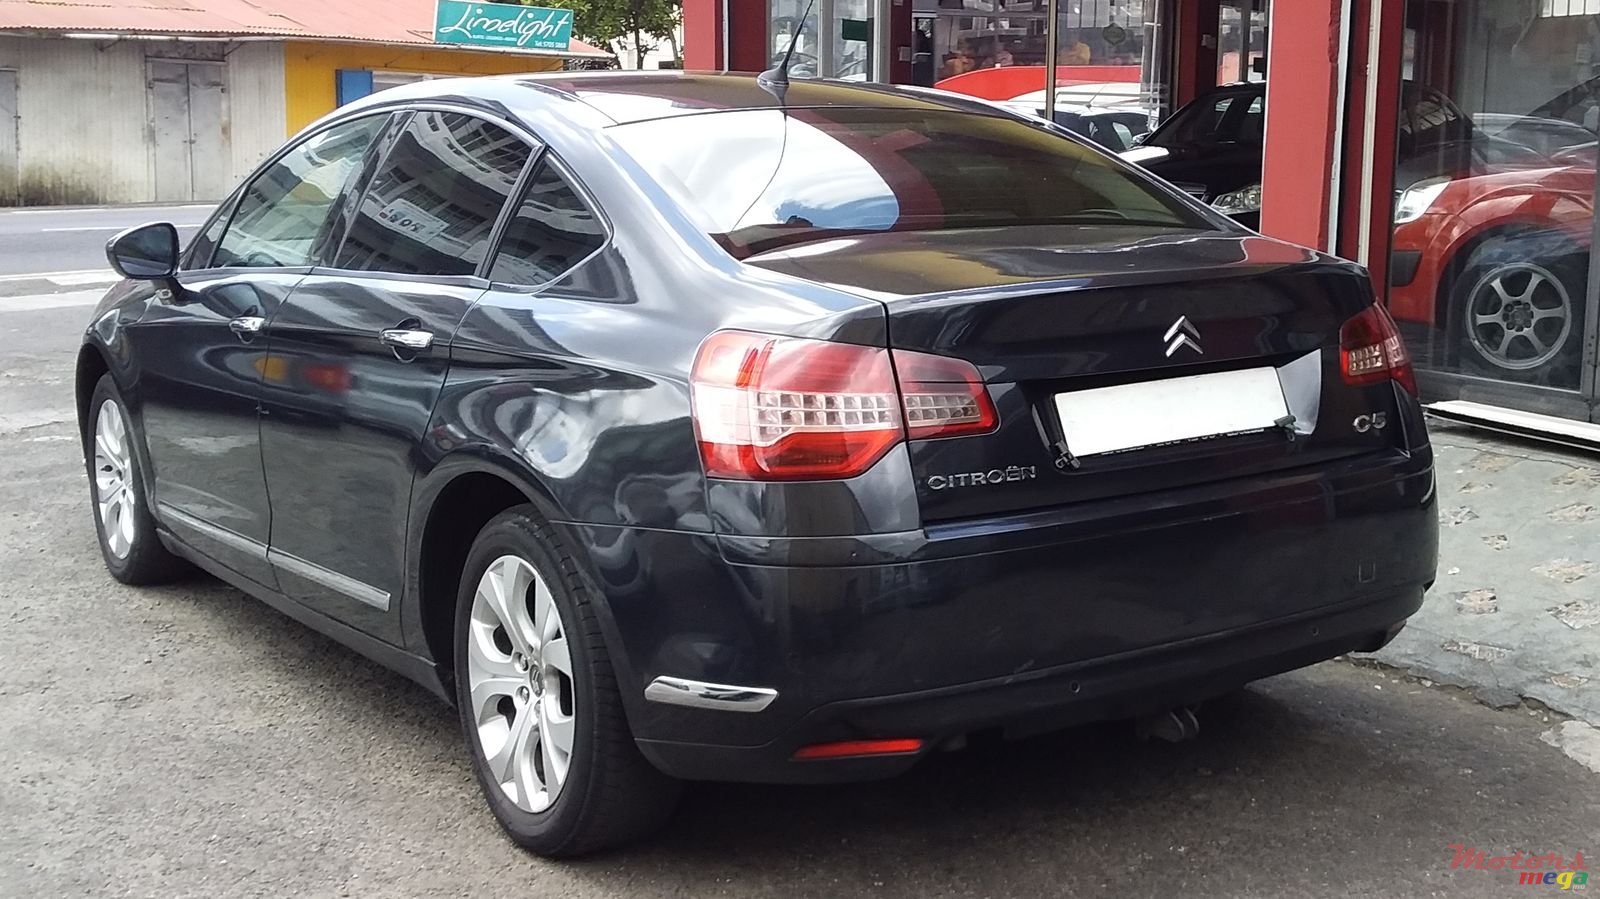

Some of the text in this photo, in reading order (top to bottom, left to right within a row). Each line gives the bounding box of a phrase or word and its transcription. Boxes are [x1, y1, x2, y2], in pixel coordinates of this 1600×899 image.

[439, 4, 570, 46] Limelight
[1353, 411, 1386, 432] C5
[928, 465, 1036, 490] CITROËN
